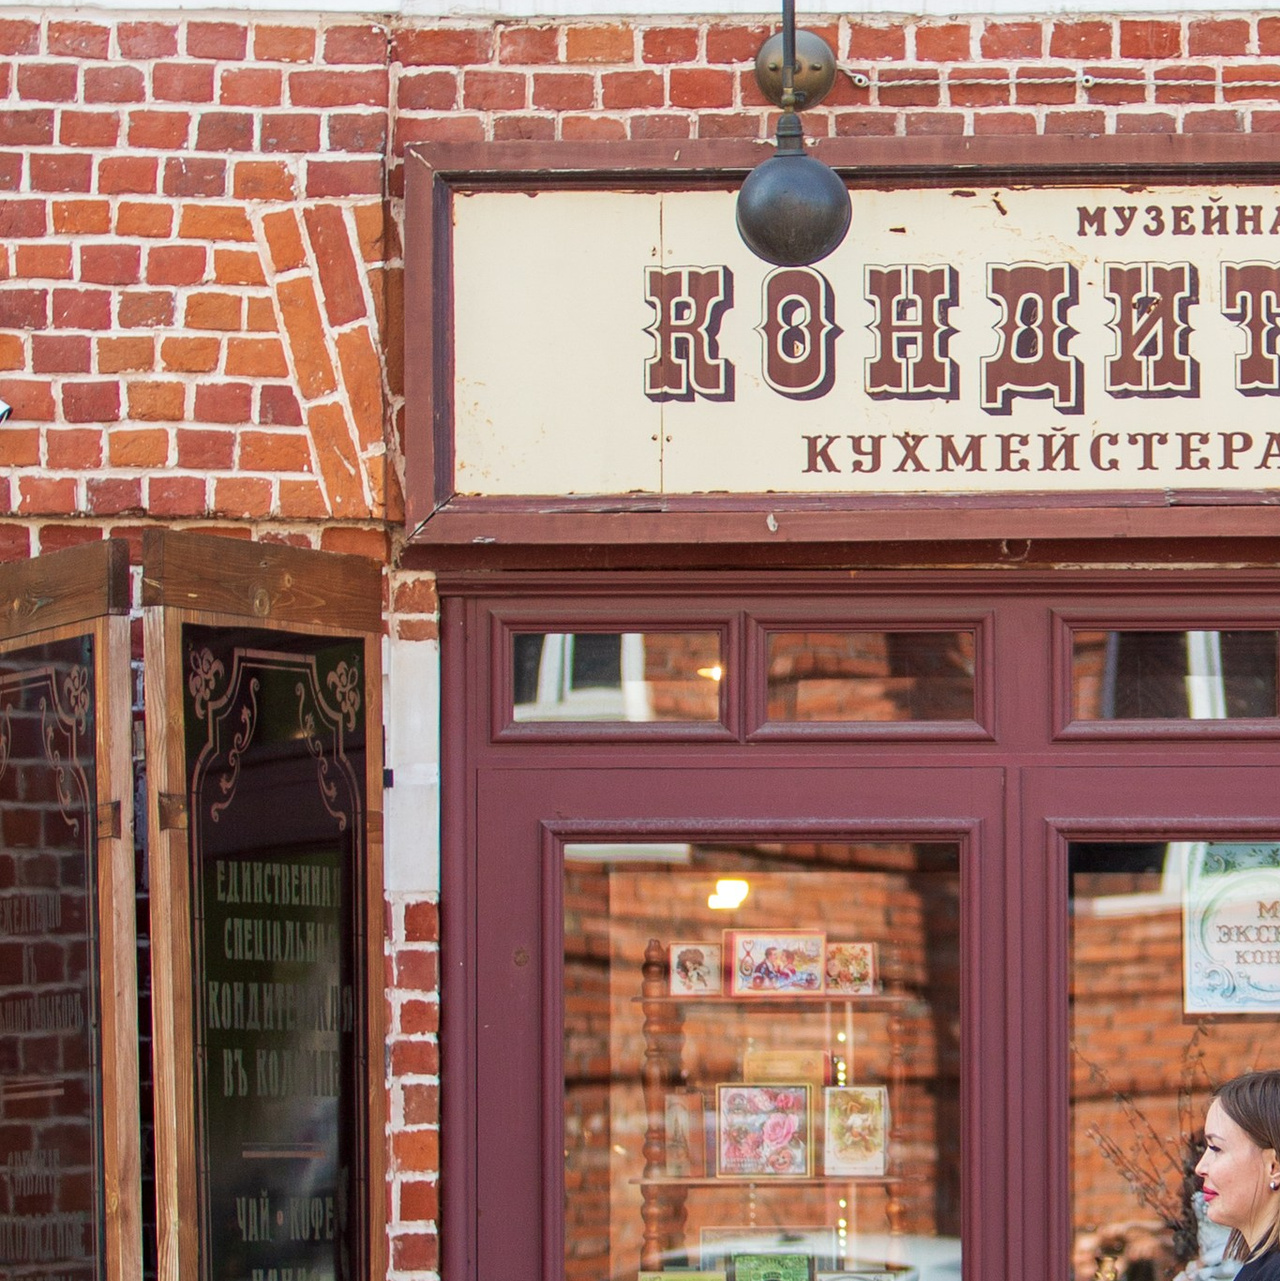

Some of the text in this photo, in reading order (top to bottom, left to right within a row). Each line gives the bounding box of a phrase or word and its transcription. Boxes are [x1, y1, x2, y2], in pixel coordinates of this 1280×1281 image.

[217, 860, 342, 907] ЕДИНСТВЕННАЯ
[222, 1048, 248, 1097] ВЪ
[236, 1188, 334, 1242] ЧАЙ КОФЕ
